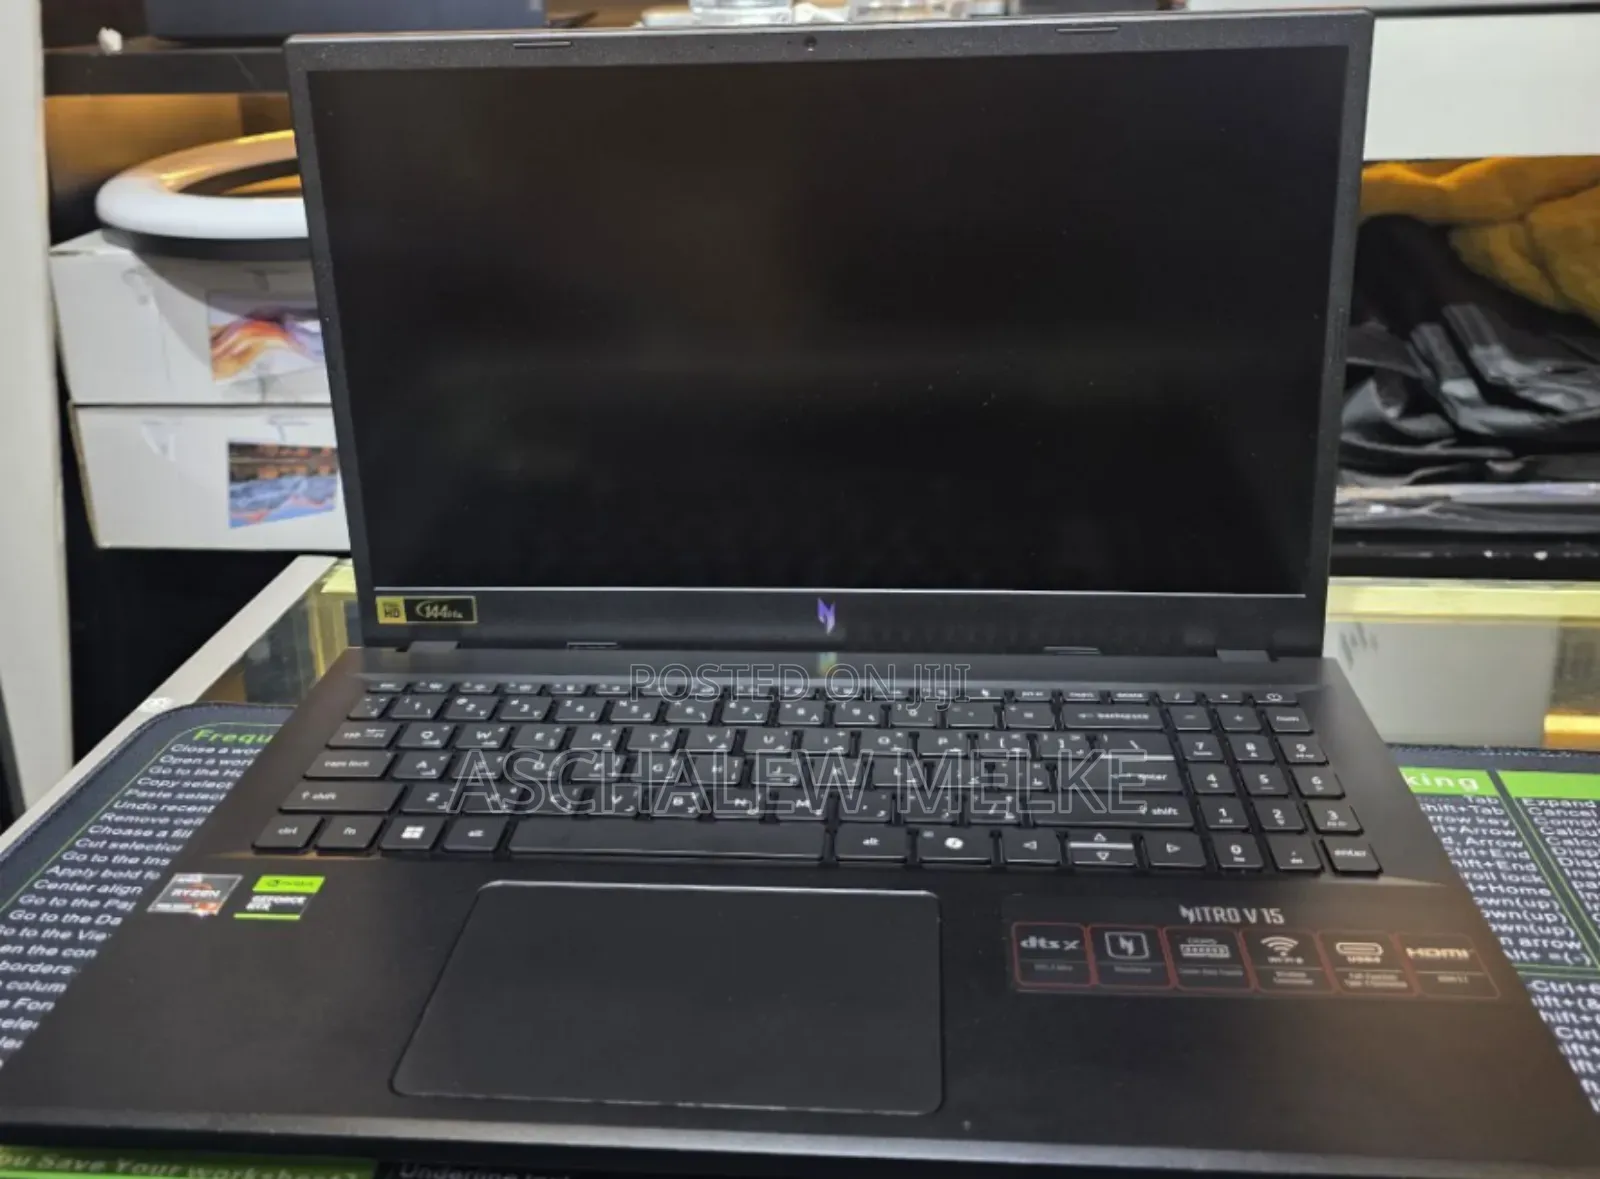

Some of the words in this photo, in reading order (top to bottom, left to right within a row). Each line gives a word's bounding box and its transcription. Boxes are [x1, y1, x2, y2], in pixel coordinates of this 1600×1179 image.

[171, 743, 216, 754] Close
[159, 754, 202, 766] Open
[149, 765, 172, 776] Go
[175, 767, 191, 776] to
[194, 768, 219, 777] the
[137, 776, 180, 788] Copy
[123, 788, 172, 799] Paste
[113, 800, 158, 811] Undo
[1152, 807, 1179, 816] shift
[100, 811, 171, 825] Remove
[156, 829, 167, 838] a
[1540, 826, 1600, 837] Calcu
[75, 837, 106, 848] Cut
[62, 850, 88, 862] Go
[90, 853, 109, 863] to
[111, 854, 141, 865] the
[46, 865, 99, 879] Apply
[100, 868, 144, 880] bold
[33, 879, 97, 892] Center
[97, 883, 143, 896] align
[19, 894, 46, 905] Go
[49, 897, 68, 907] to
[70, 898, 101, 908] the
[8, 909, 37, 921] Go
[39, 912, 58, 922] to
[61, 913, 93, 924] the
[1243, 907, 1257, 924] V
[1260, 907, 1285, 925] 15
[19, 926, 39, 938] to
[41, 928, 73, 940] the
[78, 929, 113, 942] Vie
[27, 944, 58, 956] the
[36, 1154, 106, 1171] Save
[115, 1157, 184, 1174] Your
